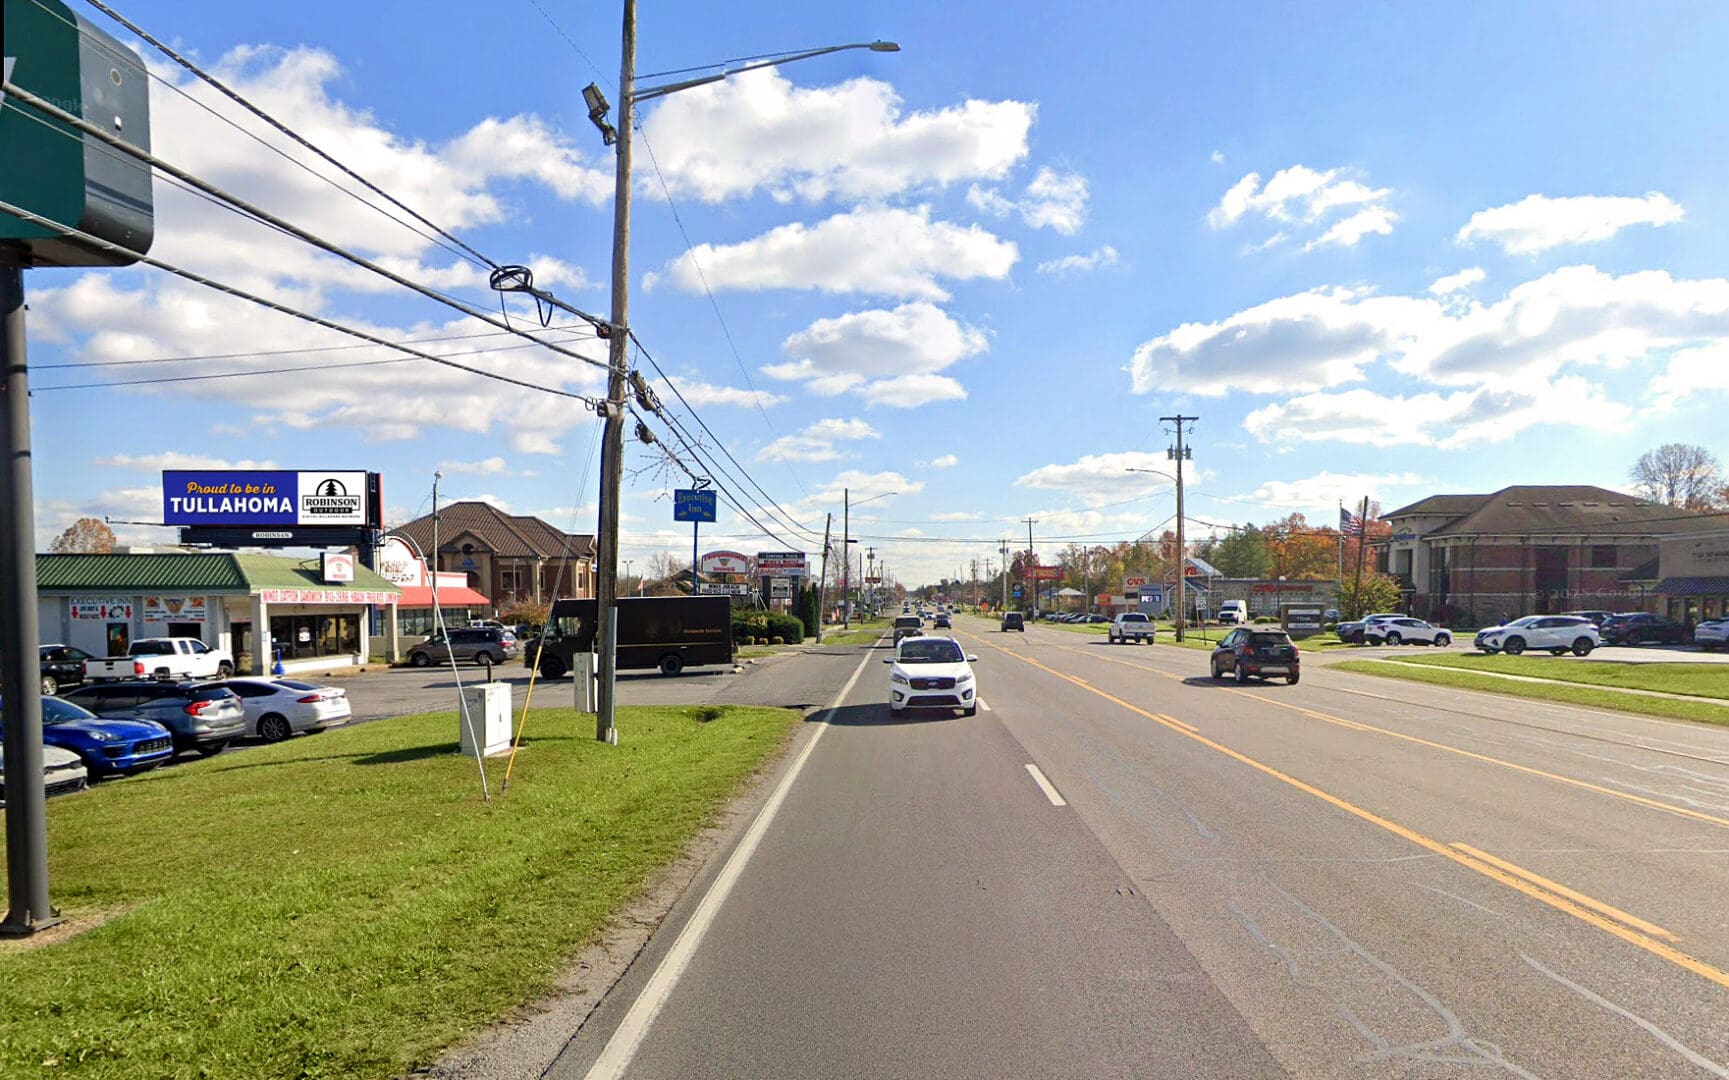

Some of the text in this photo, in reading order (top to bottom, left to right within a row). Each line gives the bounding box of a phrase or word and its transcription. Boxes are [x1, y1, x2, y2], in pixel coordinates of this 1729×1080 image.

[186, 481, 276, 494] Proud to be in
[170, 497, 293, 513] TULLAHOMA
[305, 498, 358, 506] ROBINSON
[1127, 577, 1146, 586] CVS
